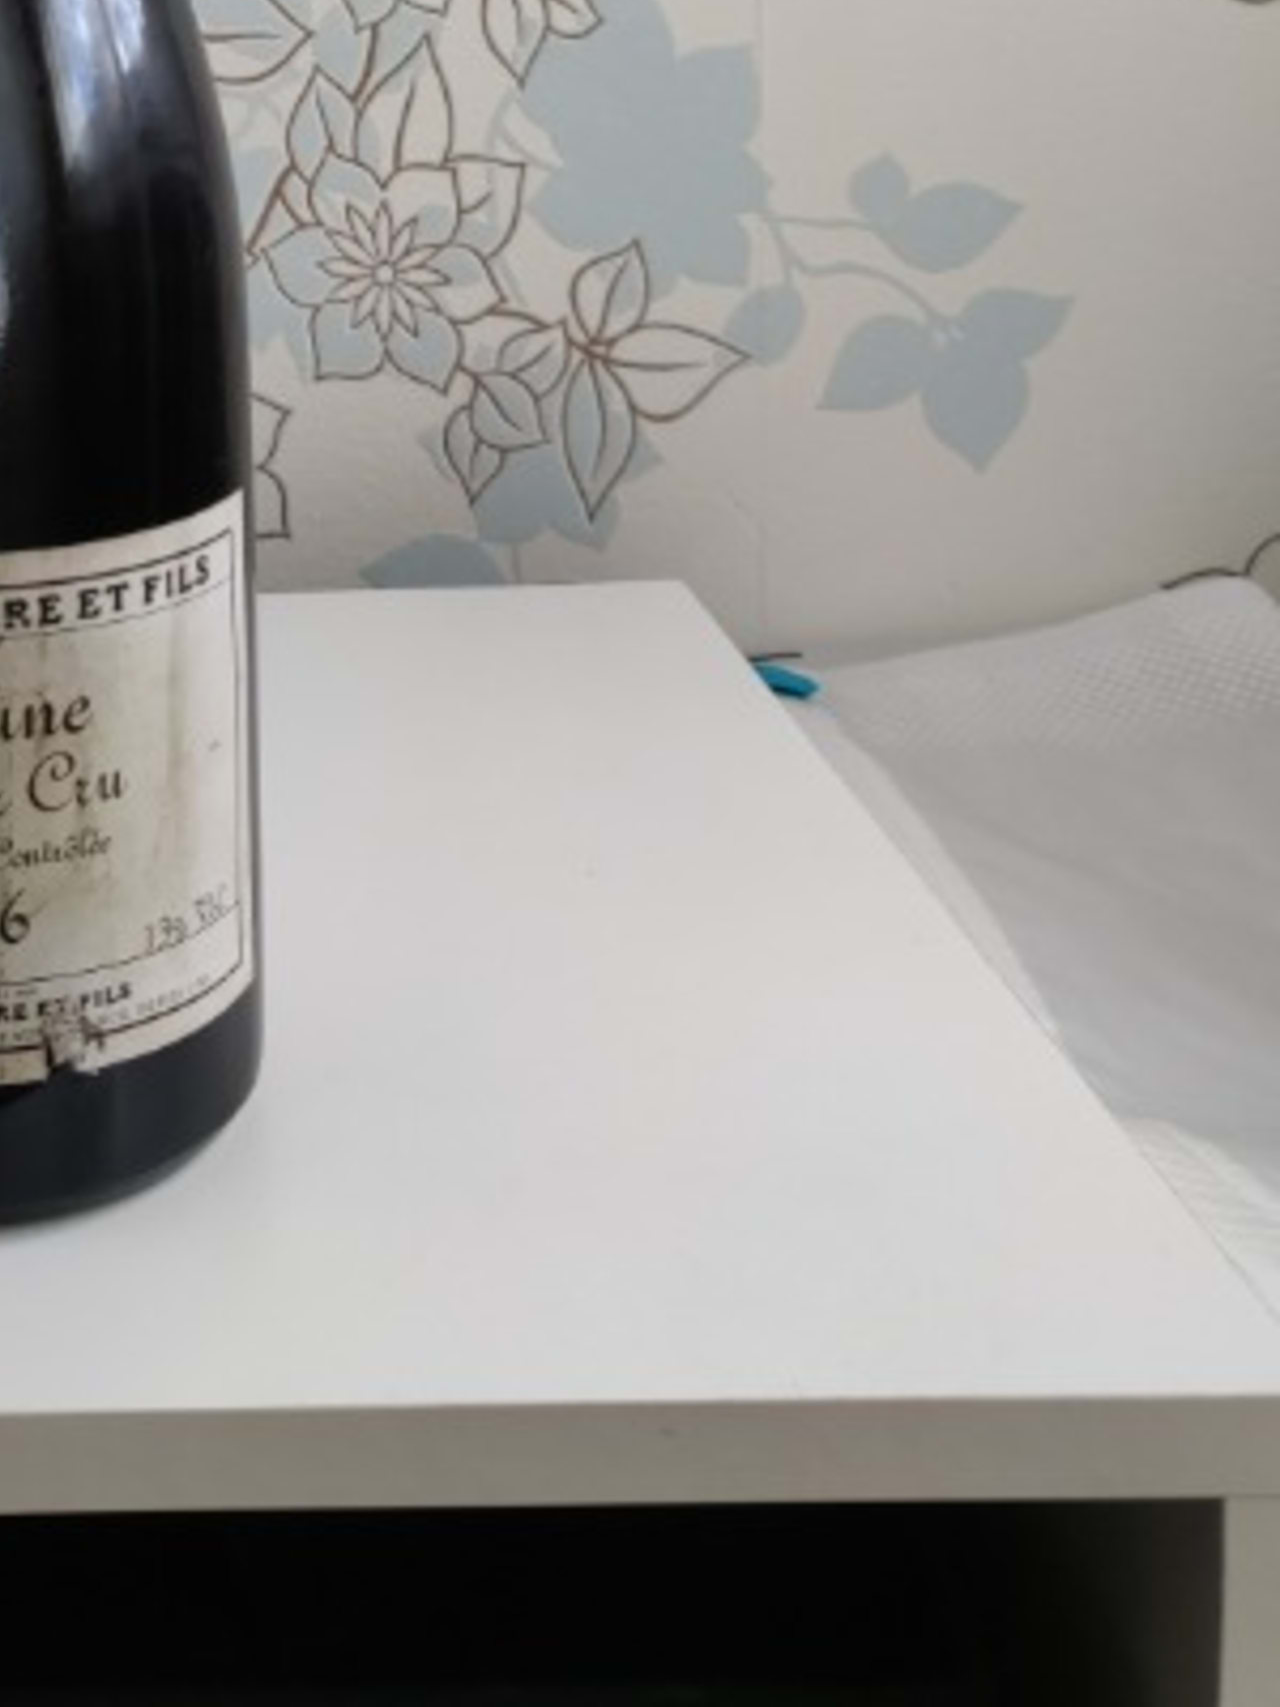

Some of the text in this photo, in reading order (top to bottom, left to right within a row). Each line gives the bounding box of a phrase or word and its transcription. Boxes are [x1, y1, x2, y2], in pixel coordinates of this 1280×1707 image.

[77, 582, 129, 620] ET
[142, 555, 210, 604] FILS
[27, 750, 124, 812] Cru
